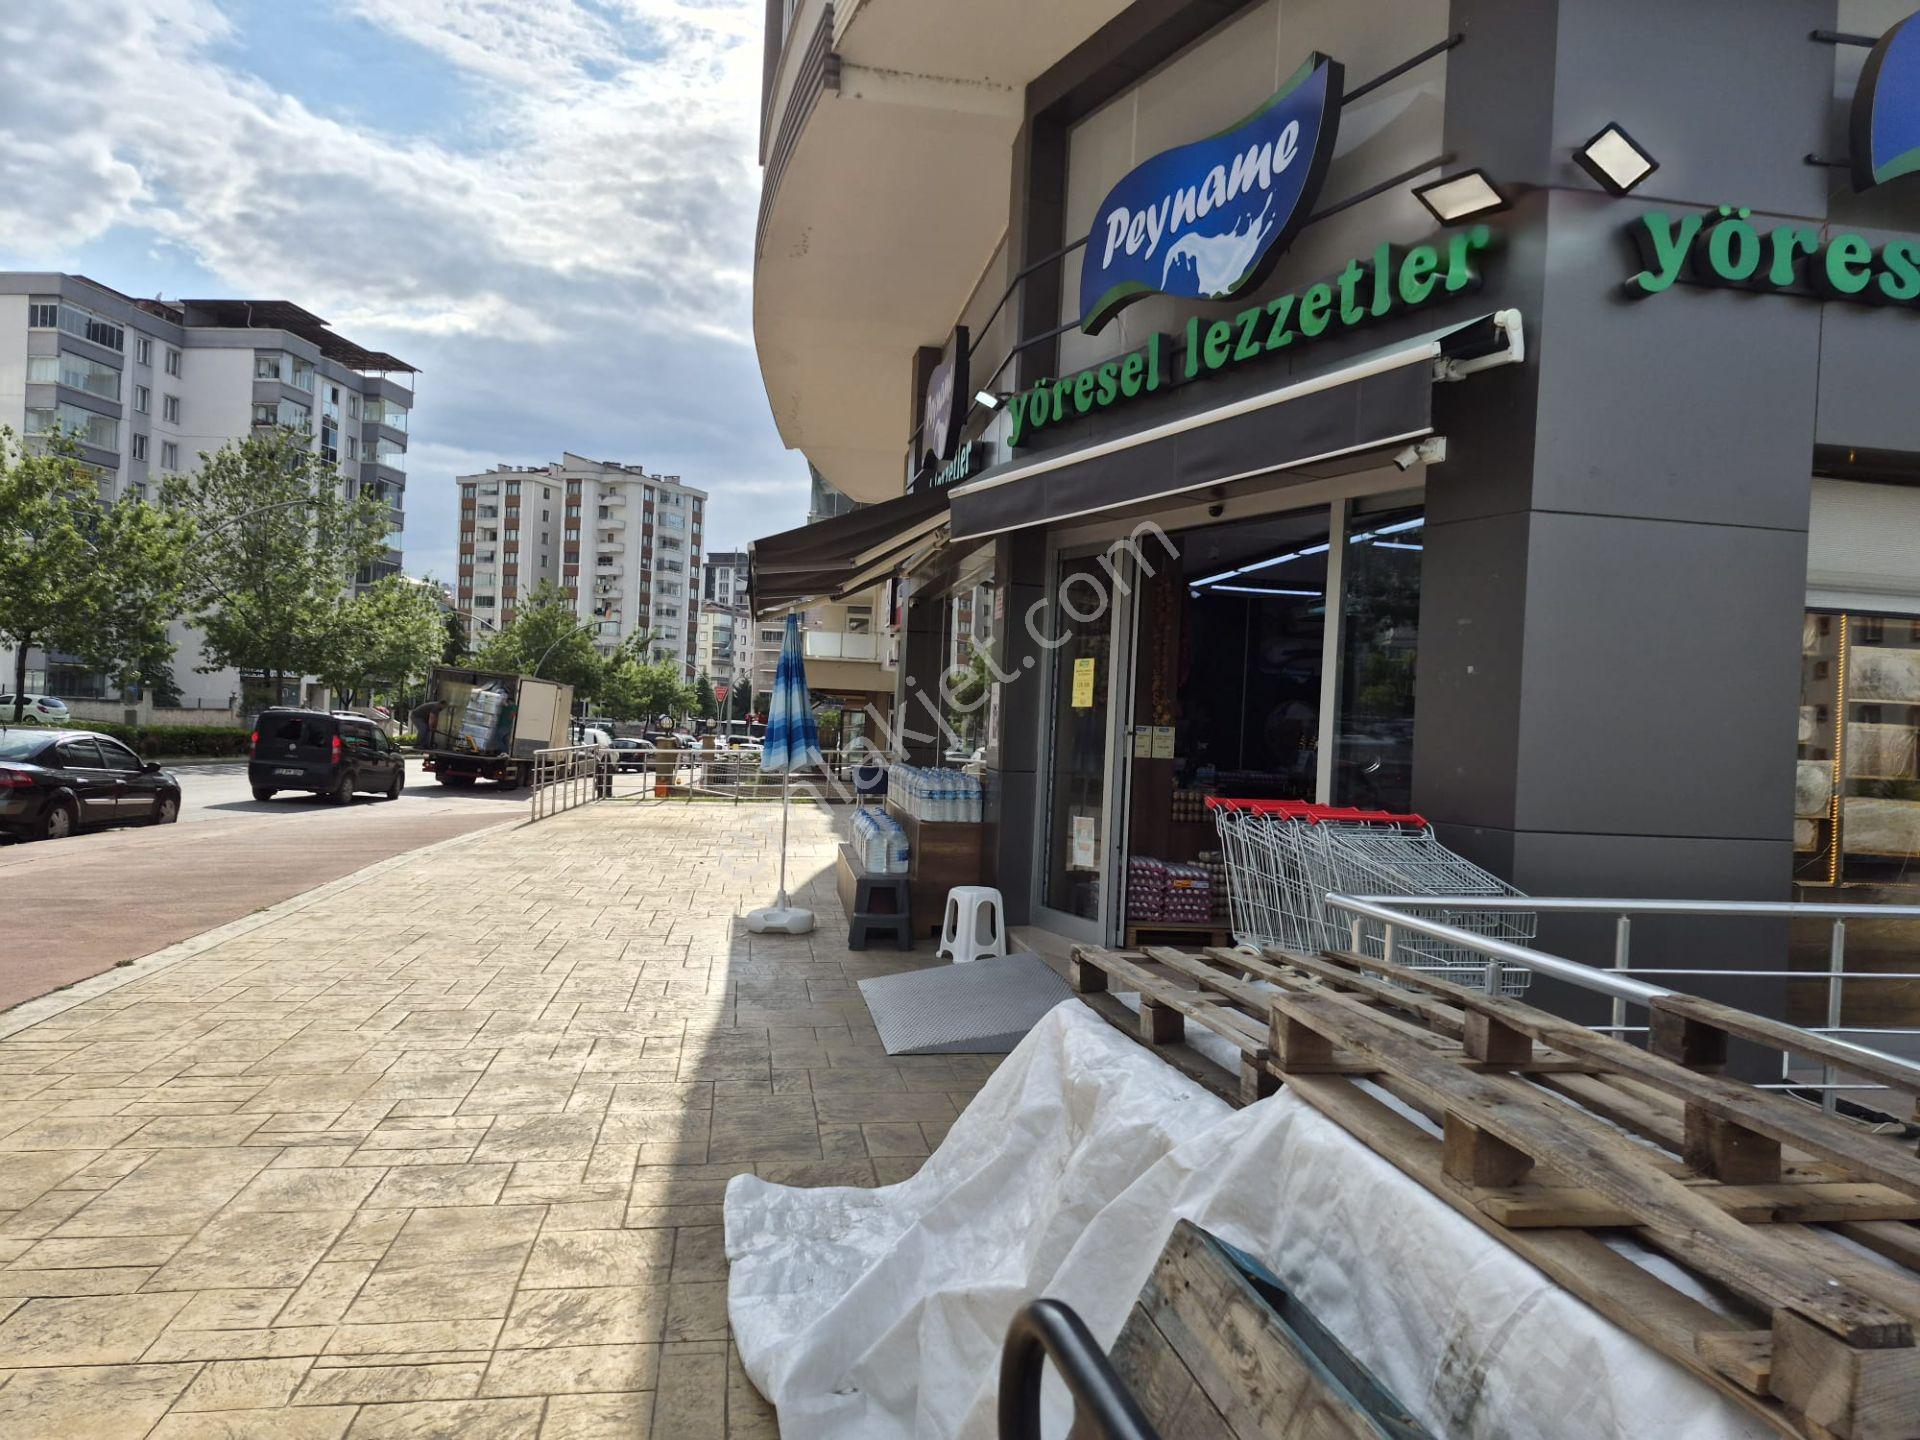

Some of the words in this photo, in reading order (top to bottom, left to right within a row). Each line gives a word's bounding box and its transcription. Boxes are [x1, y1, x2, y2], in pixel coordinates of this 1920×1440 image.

[1102, 120, 1300, 269] Peyname
[1636, 204, 1920, 300] yöres
[1006, 331, 1161, 447] yöresel
[1184, 224, 1491, 378] lezzetler
